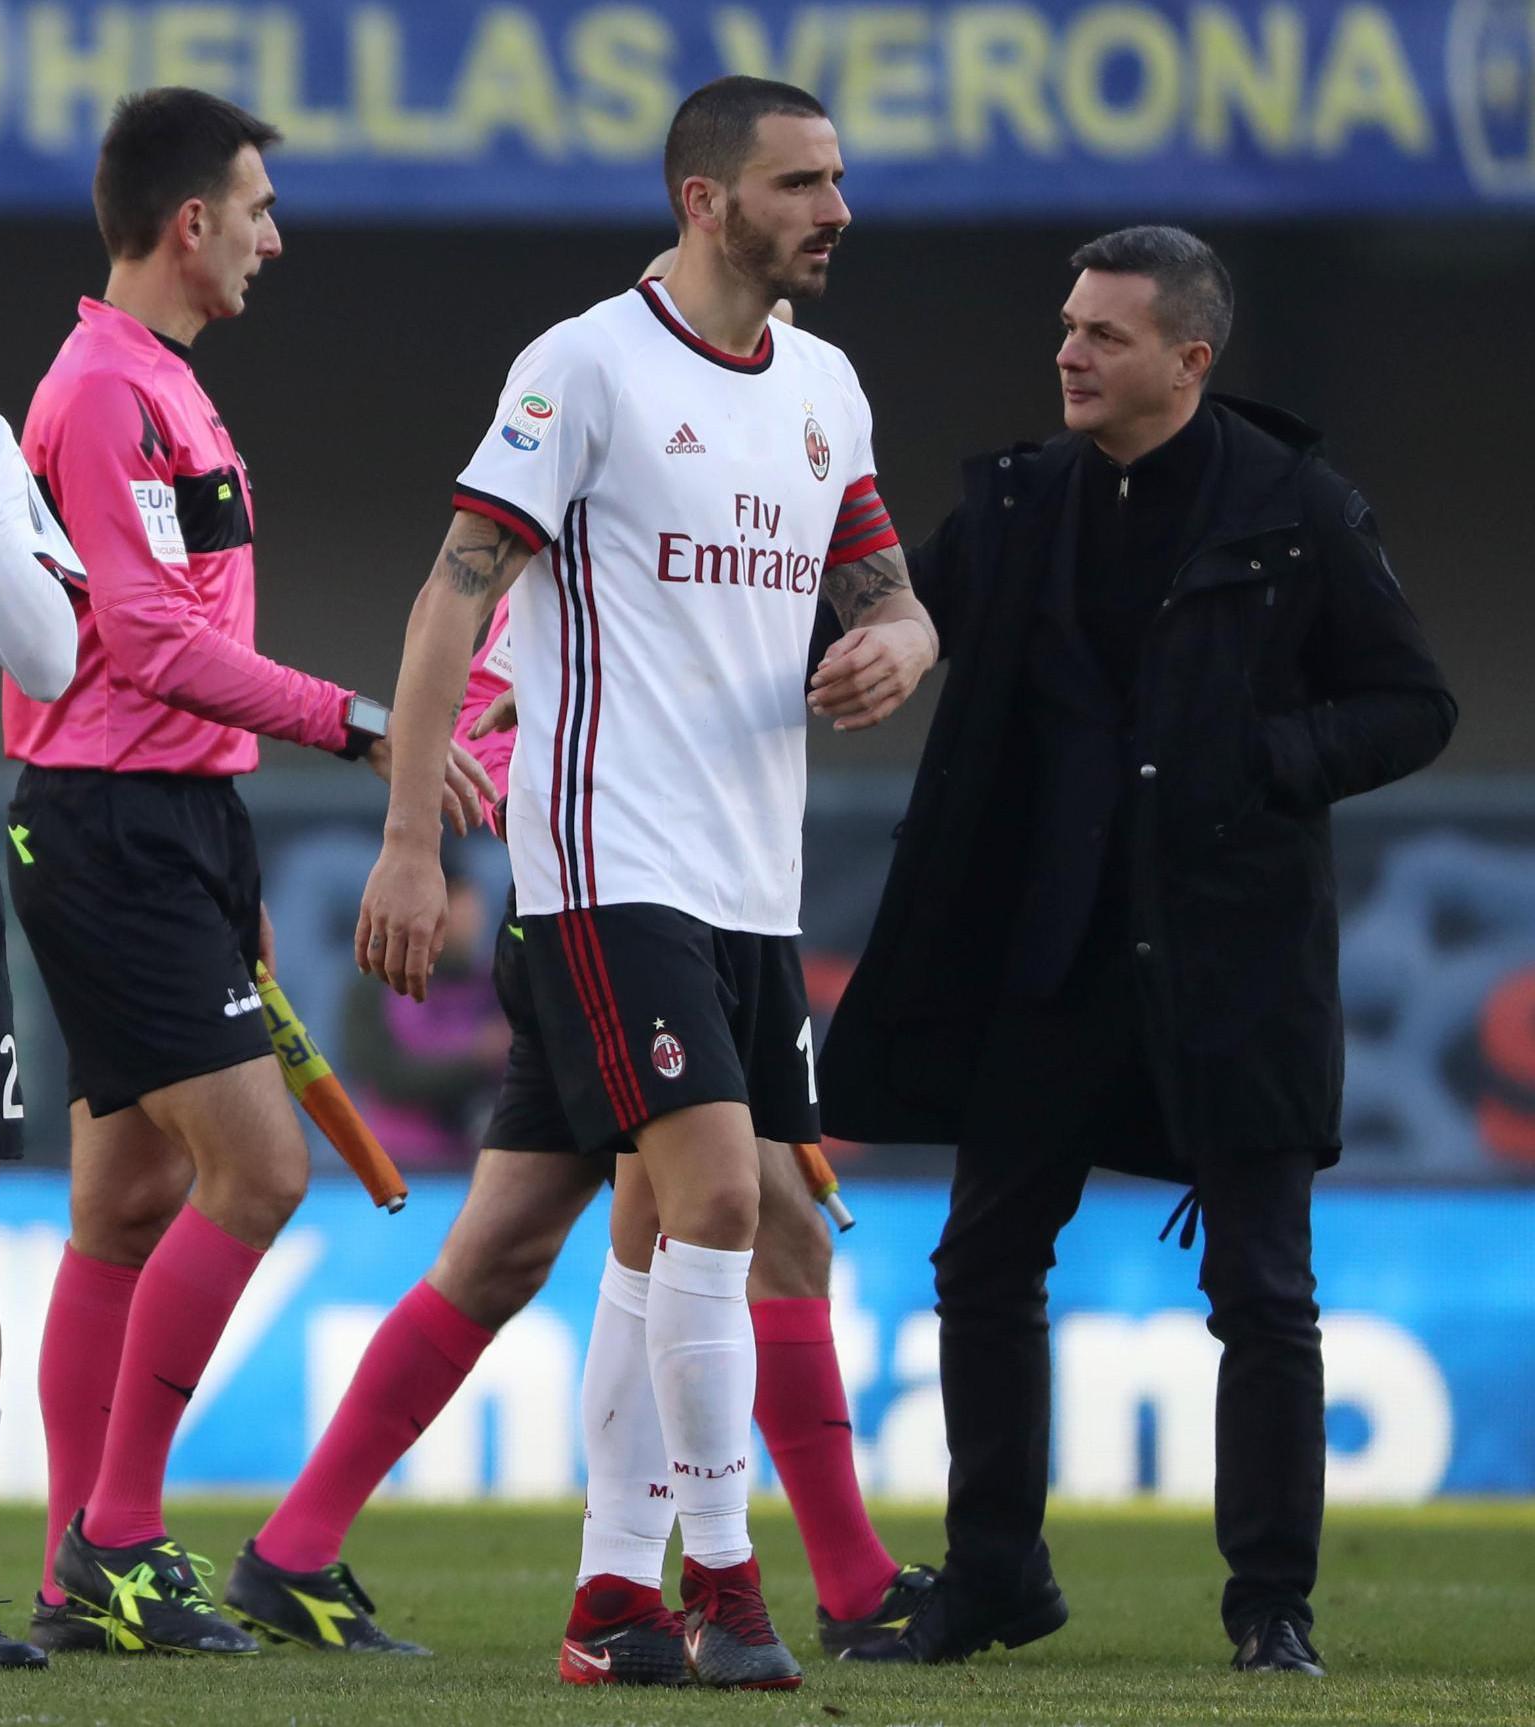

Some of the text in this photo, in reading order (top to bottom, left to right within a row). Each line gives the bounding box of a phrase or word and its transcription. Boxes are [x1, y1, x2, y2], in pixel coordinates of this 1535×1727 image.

[26, 3, 1436, 158] HELLAS VERONA
[515, 434, 534, 450] TIM
[665, 442, 706, 454] adidas
[734, 494, 781, 538] Fly
[657, 532, 821, 596] Emirates
[0, 1033, 25, 1120] 2
[673, 1456, 747, 1479] MILAN
